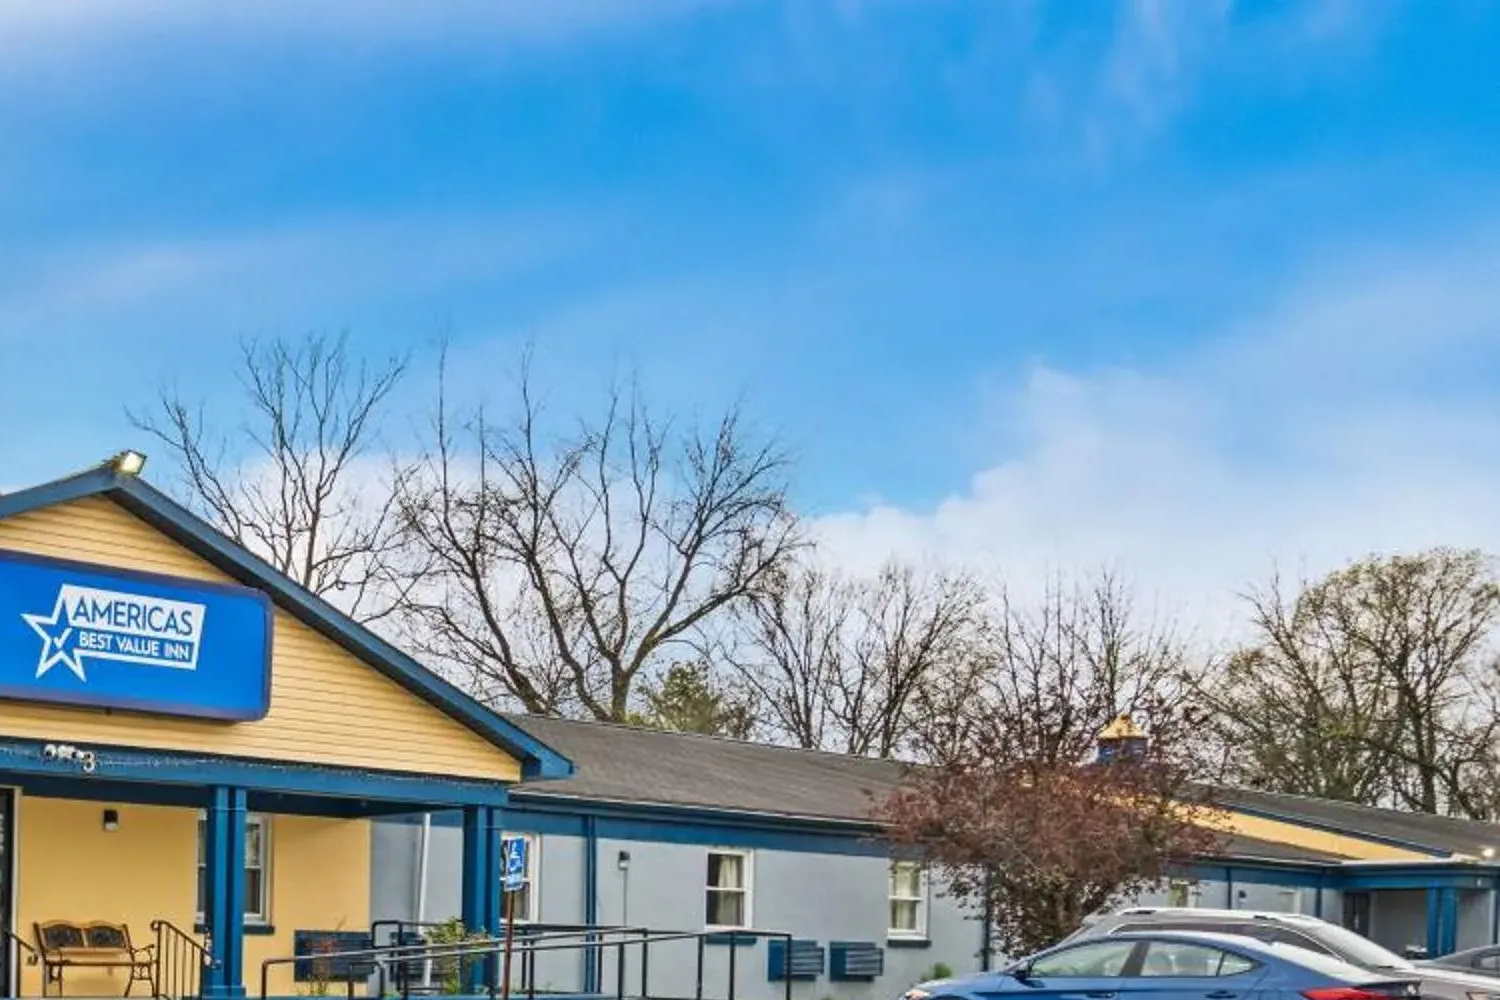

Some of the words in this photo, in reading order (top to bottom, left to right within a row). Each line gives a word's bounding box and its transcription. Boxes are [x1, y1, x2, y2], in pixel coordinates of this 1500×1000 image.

[72, 596, 193, 636] AMERICAS
[79, 630, 113, 650] BEST
[115, 635, 160, 657] VALUE
[164, 642, 190, 661] INN
